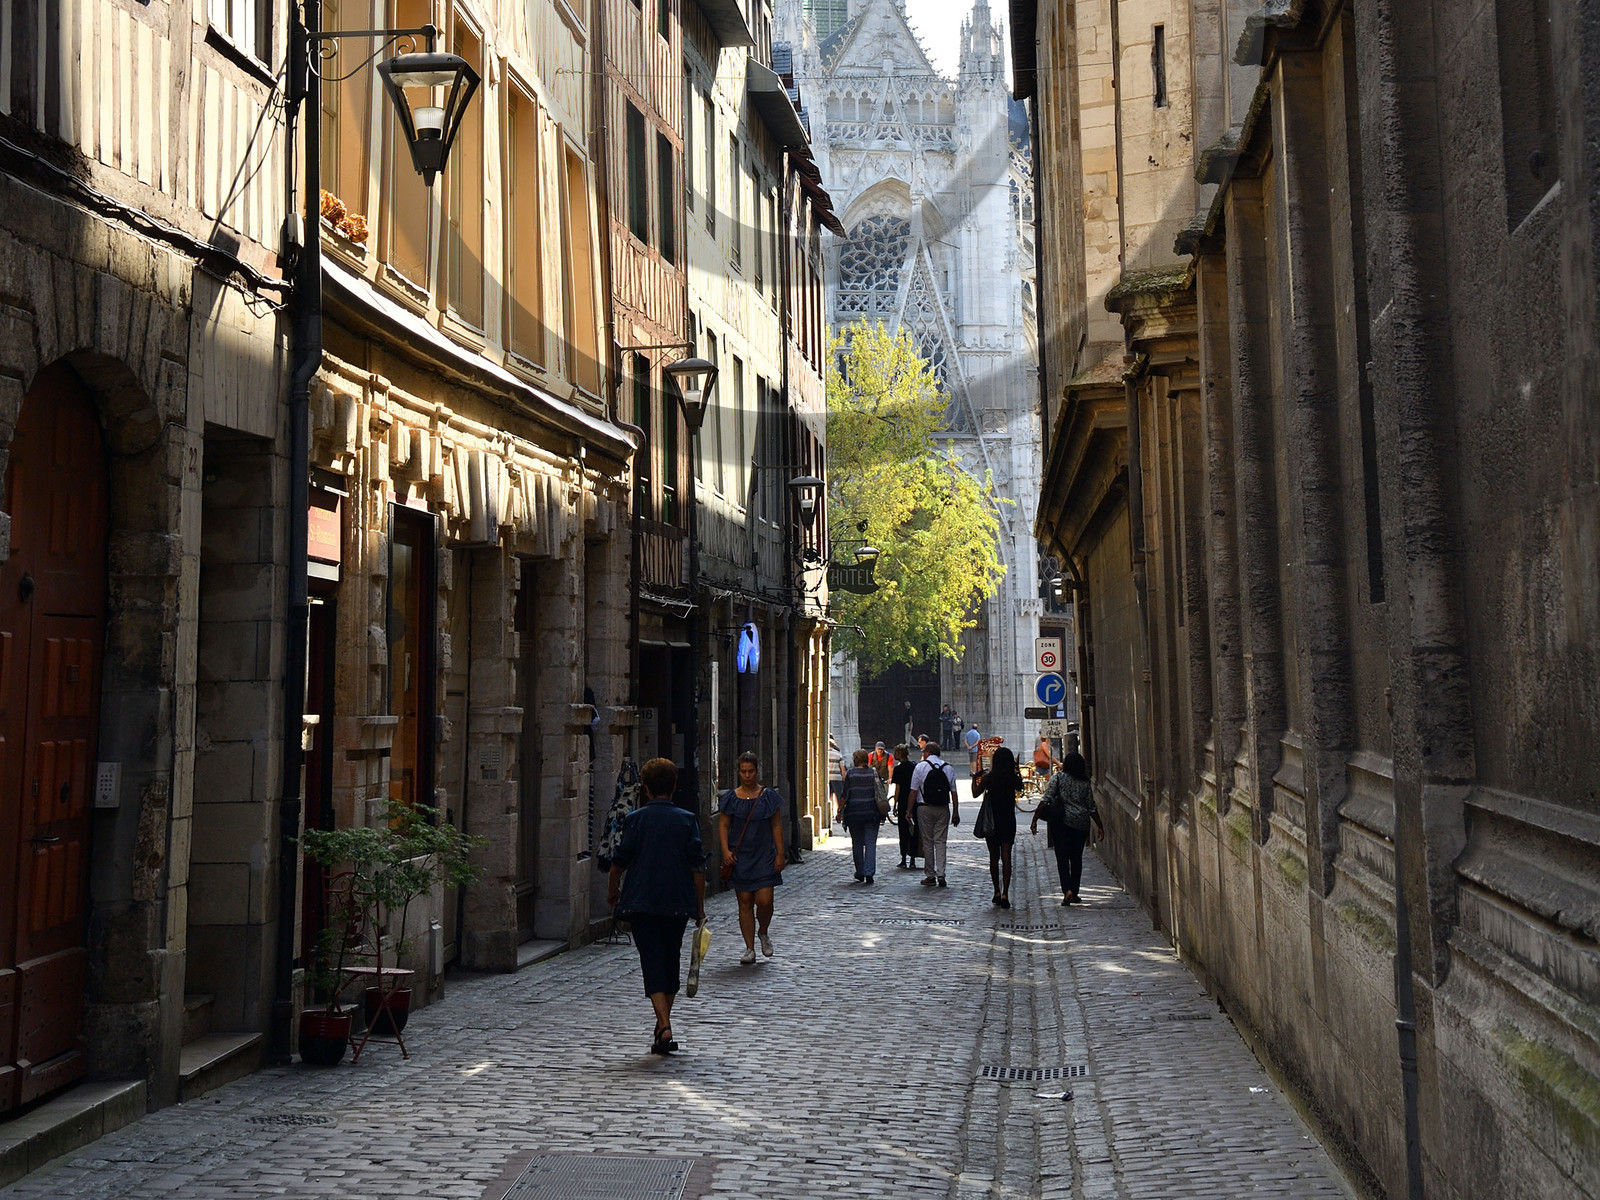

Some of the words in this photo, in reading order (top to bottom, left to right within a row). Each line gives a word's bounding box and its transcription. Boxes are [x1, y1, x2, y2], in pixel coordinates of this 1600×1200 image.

[830, 568, 874, 585] HOTEL
[1044, 655, 1053, 663] 30
[641, 709, 653, 719] 18
